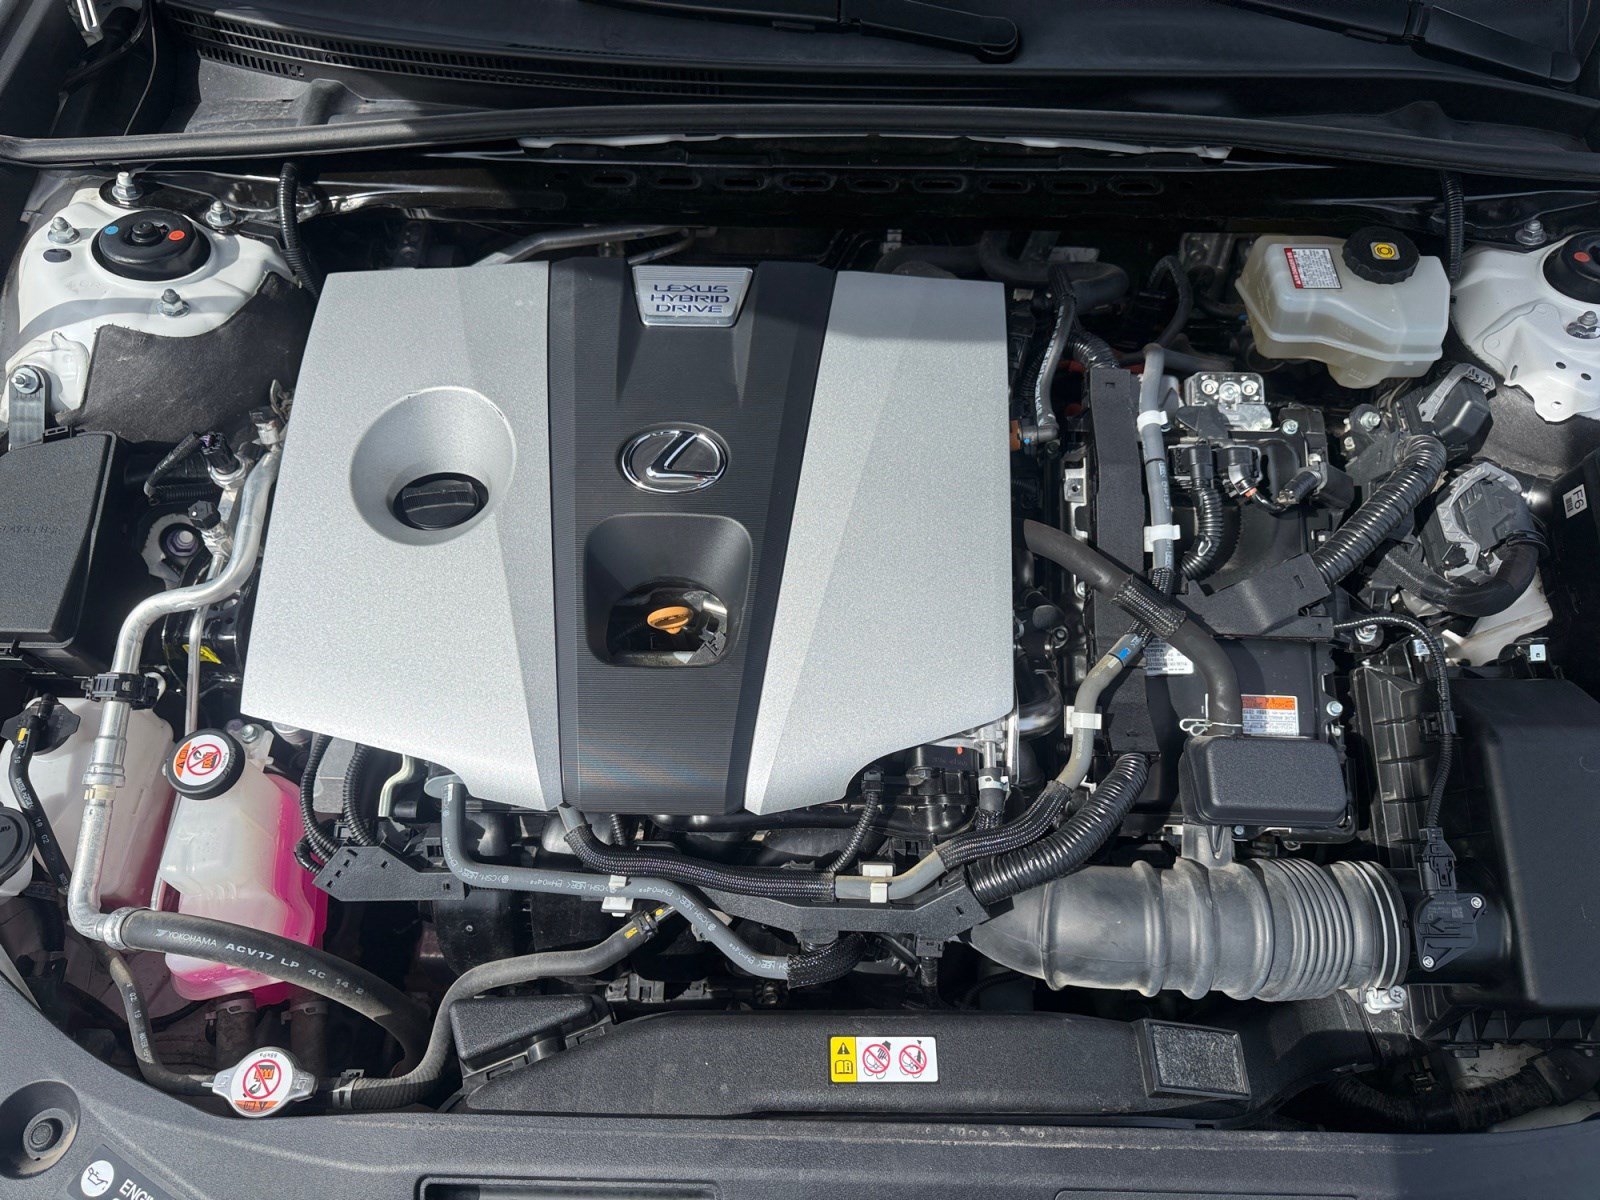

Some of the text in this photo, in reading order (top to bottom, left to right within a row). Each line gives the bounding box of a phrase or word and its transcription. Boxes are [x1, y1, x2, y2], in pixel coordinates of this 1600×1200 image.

[654, 284, 728, 293] LEXUS
[651, 294, 730, 303] HYBRID
[656, 304, 723, 313] DRIVE
[1573, 490, 1584, 509] F6
[169, 931, 217, 947] YOKOHAMA
[225, 943, 275, 961] ACV17
[280, 958, 300, 968] LP
[307, 968, 326, 979] 4C
